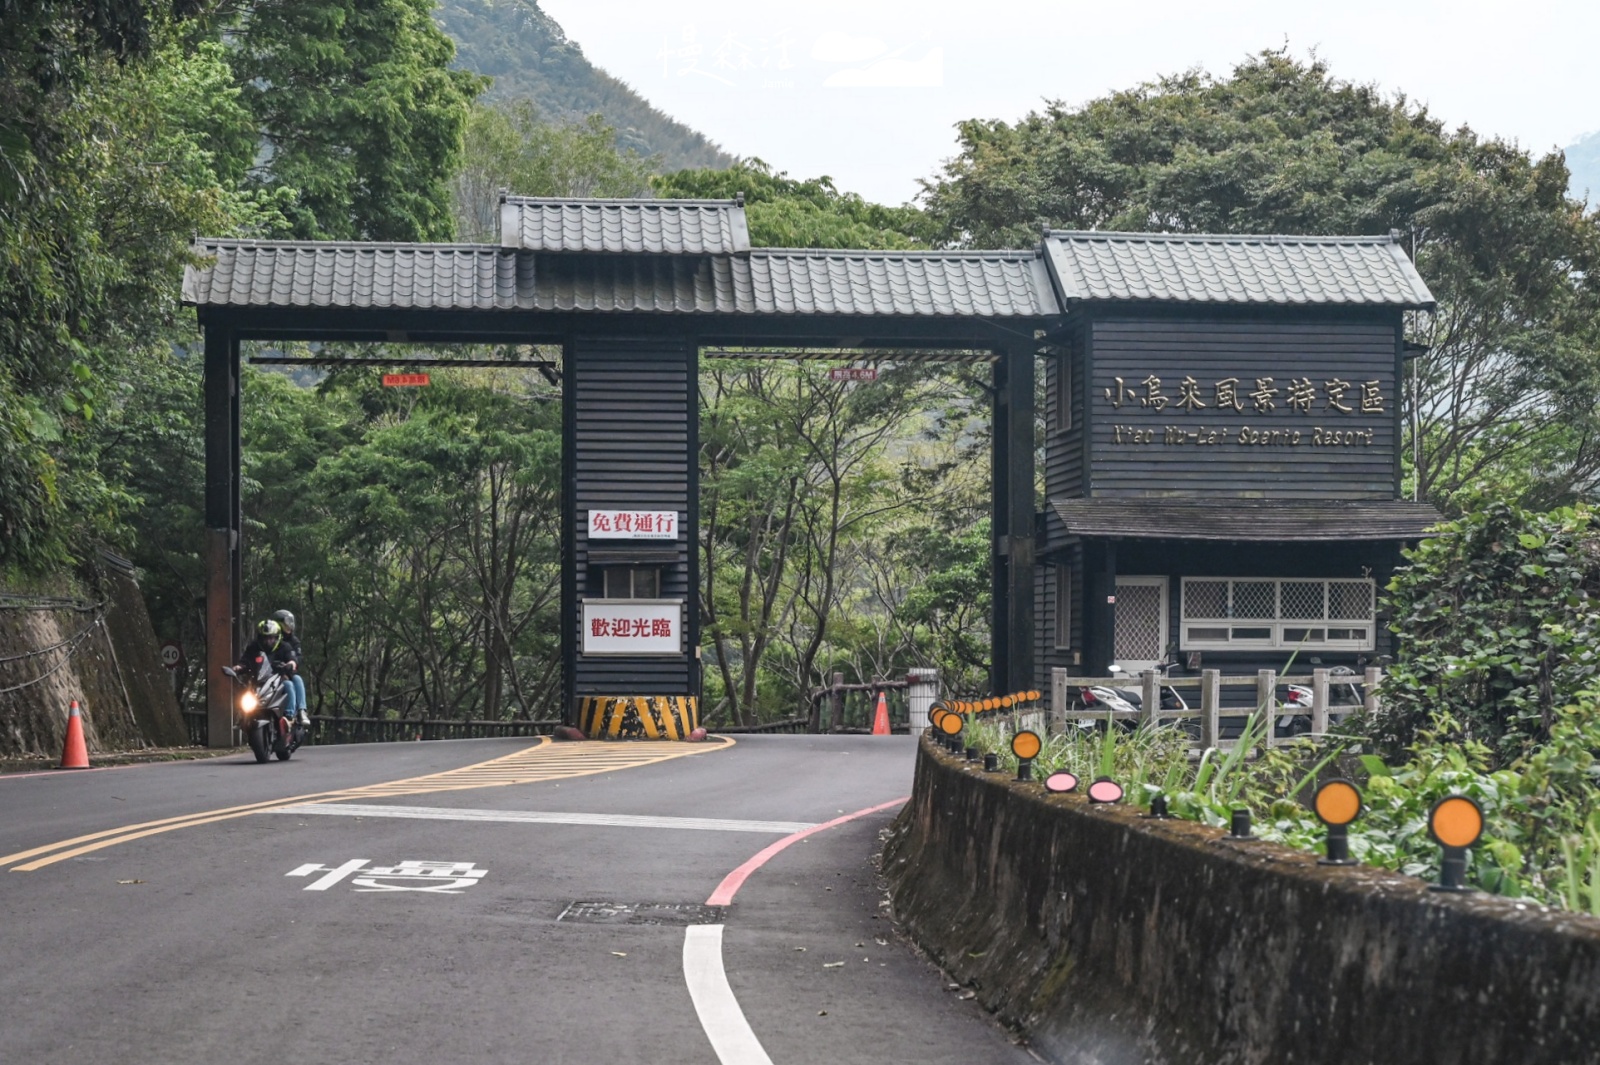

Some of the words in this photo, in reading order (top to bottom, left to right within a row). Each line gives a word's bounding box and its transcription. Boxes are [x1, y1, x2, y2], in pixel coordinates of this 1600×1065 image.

[1104, 374, 1385, 414] 小烏來風景特定區
[1113, 424, 1154, 445] Xiao
[1164, 424, 1228, 445] Wu-Lai
[1238, 424, 1300, 446] Scenic
[1311, 424, 1374, 446] Resort
[592, 512, 674, 533] 免費通行
[592, 618, 671, 638] 歡迎光臨
[163, 649, 178, 660] 40
[284, 858, 489, 894] 慢
